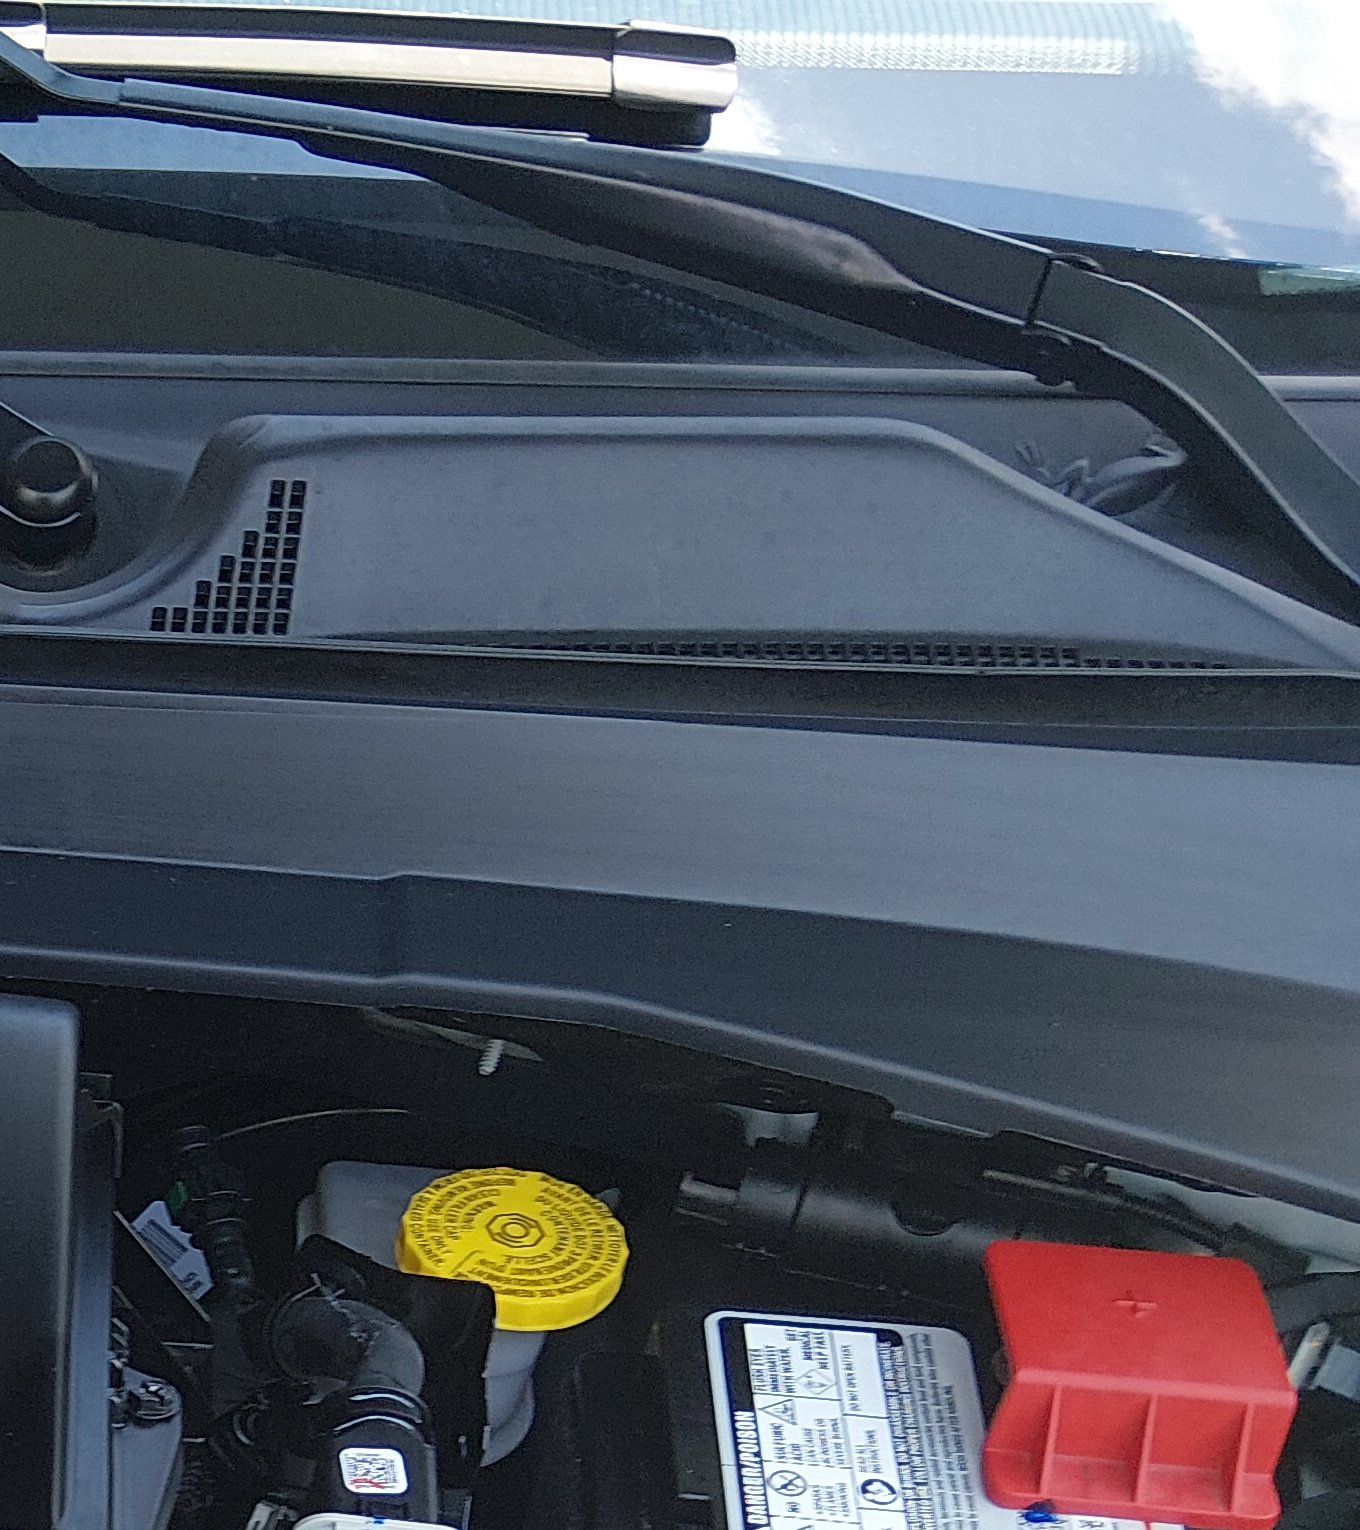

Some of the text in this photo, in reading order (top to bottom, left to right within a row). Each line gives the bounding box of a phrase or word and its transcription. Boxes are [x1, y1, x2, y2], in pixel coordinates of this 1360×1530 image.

[788, 1442, 803, 1462] ACID
[733, 1409, 768, 1524] DANGER/POISON
[784, 1501, 800, 1513] NO
